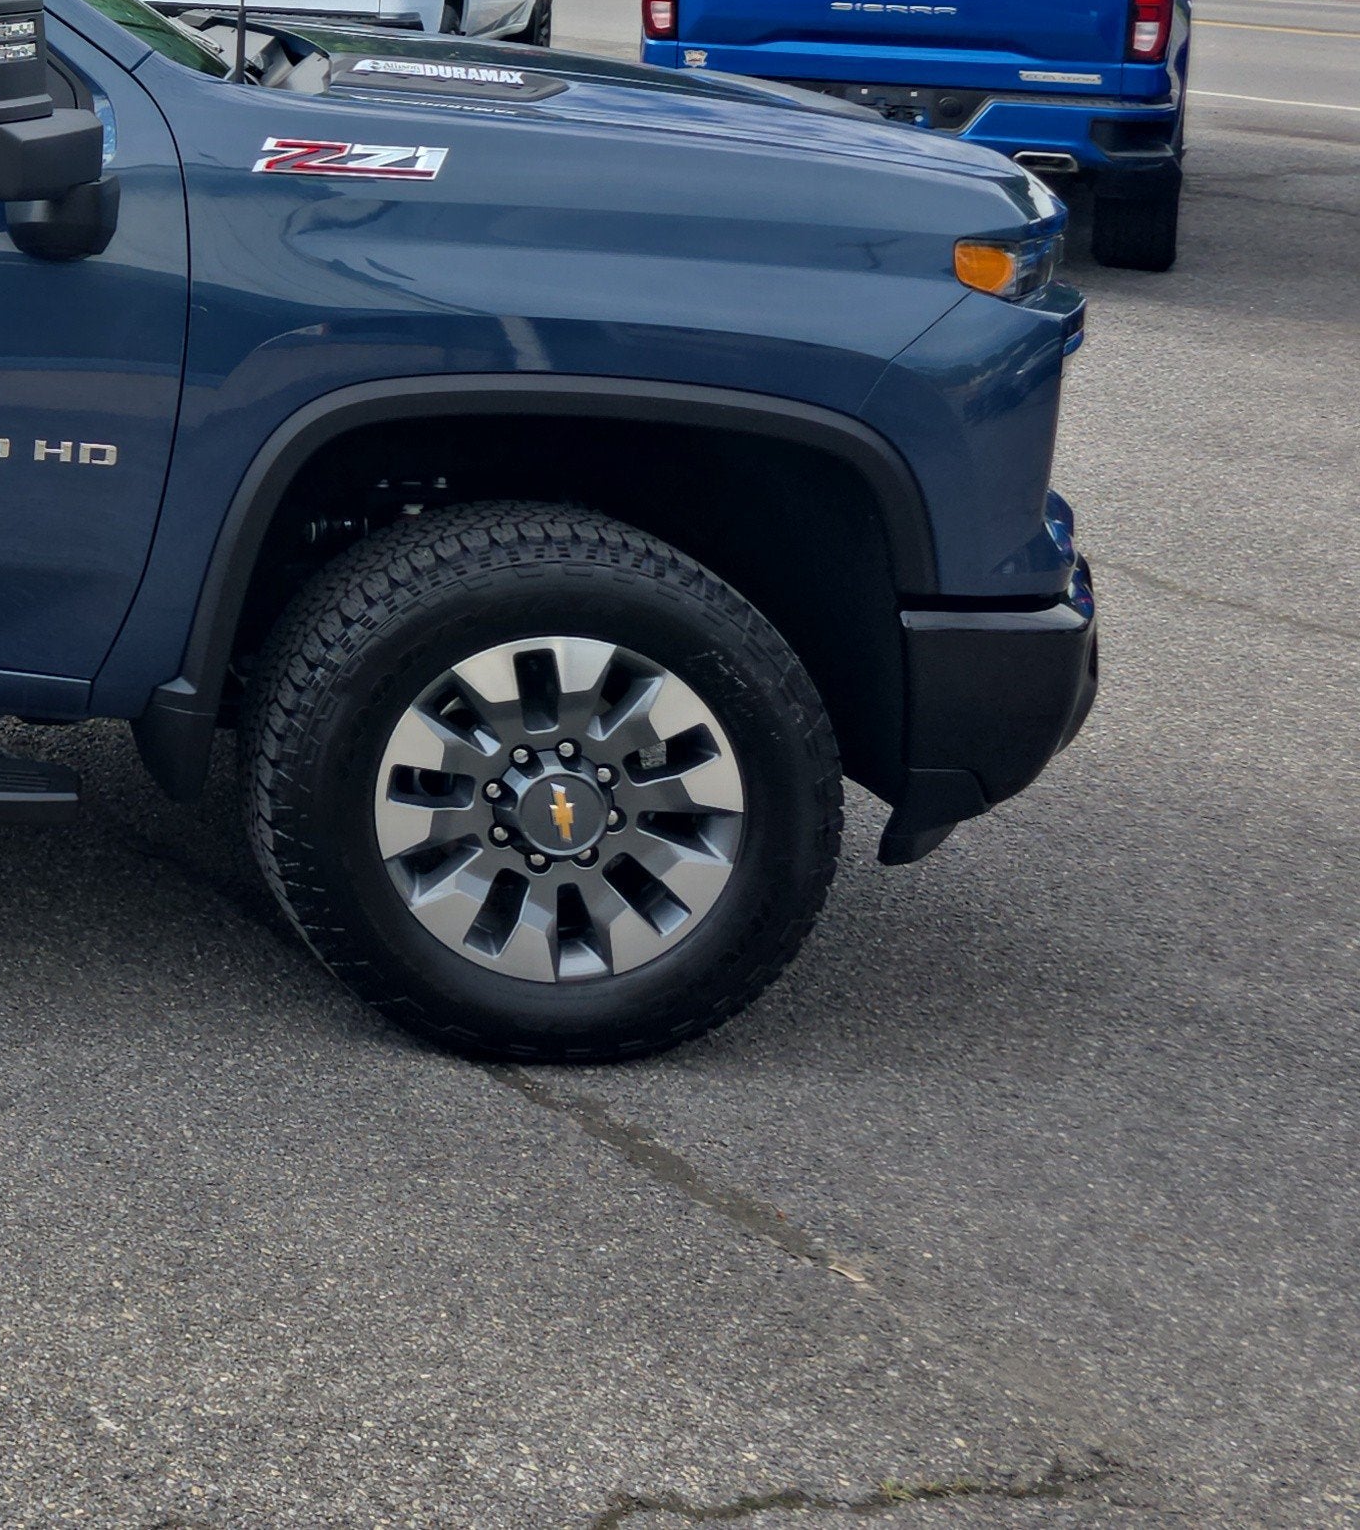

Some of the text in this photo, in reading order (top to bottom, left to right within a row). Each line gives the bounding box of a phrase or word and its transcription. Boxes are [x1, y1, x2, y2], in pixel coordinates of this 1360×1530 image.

[830, 2, 957, 15] SIERRA
[425, 64, 525, 85] DURAMAX
[252, 137, 449, 180] Z71
[34, 439, 118, 466] HD
